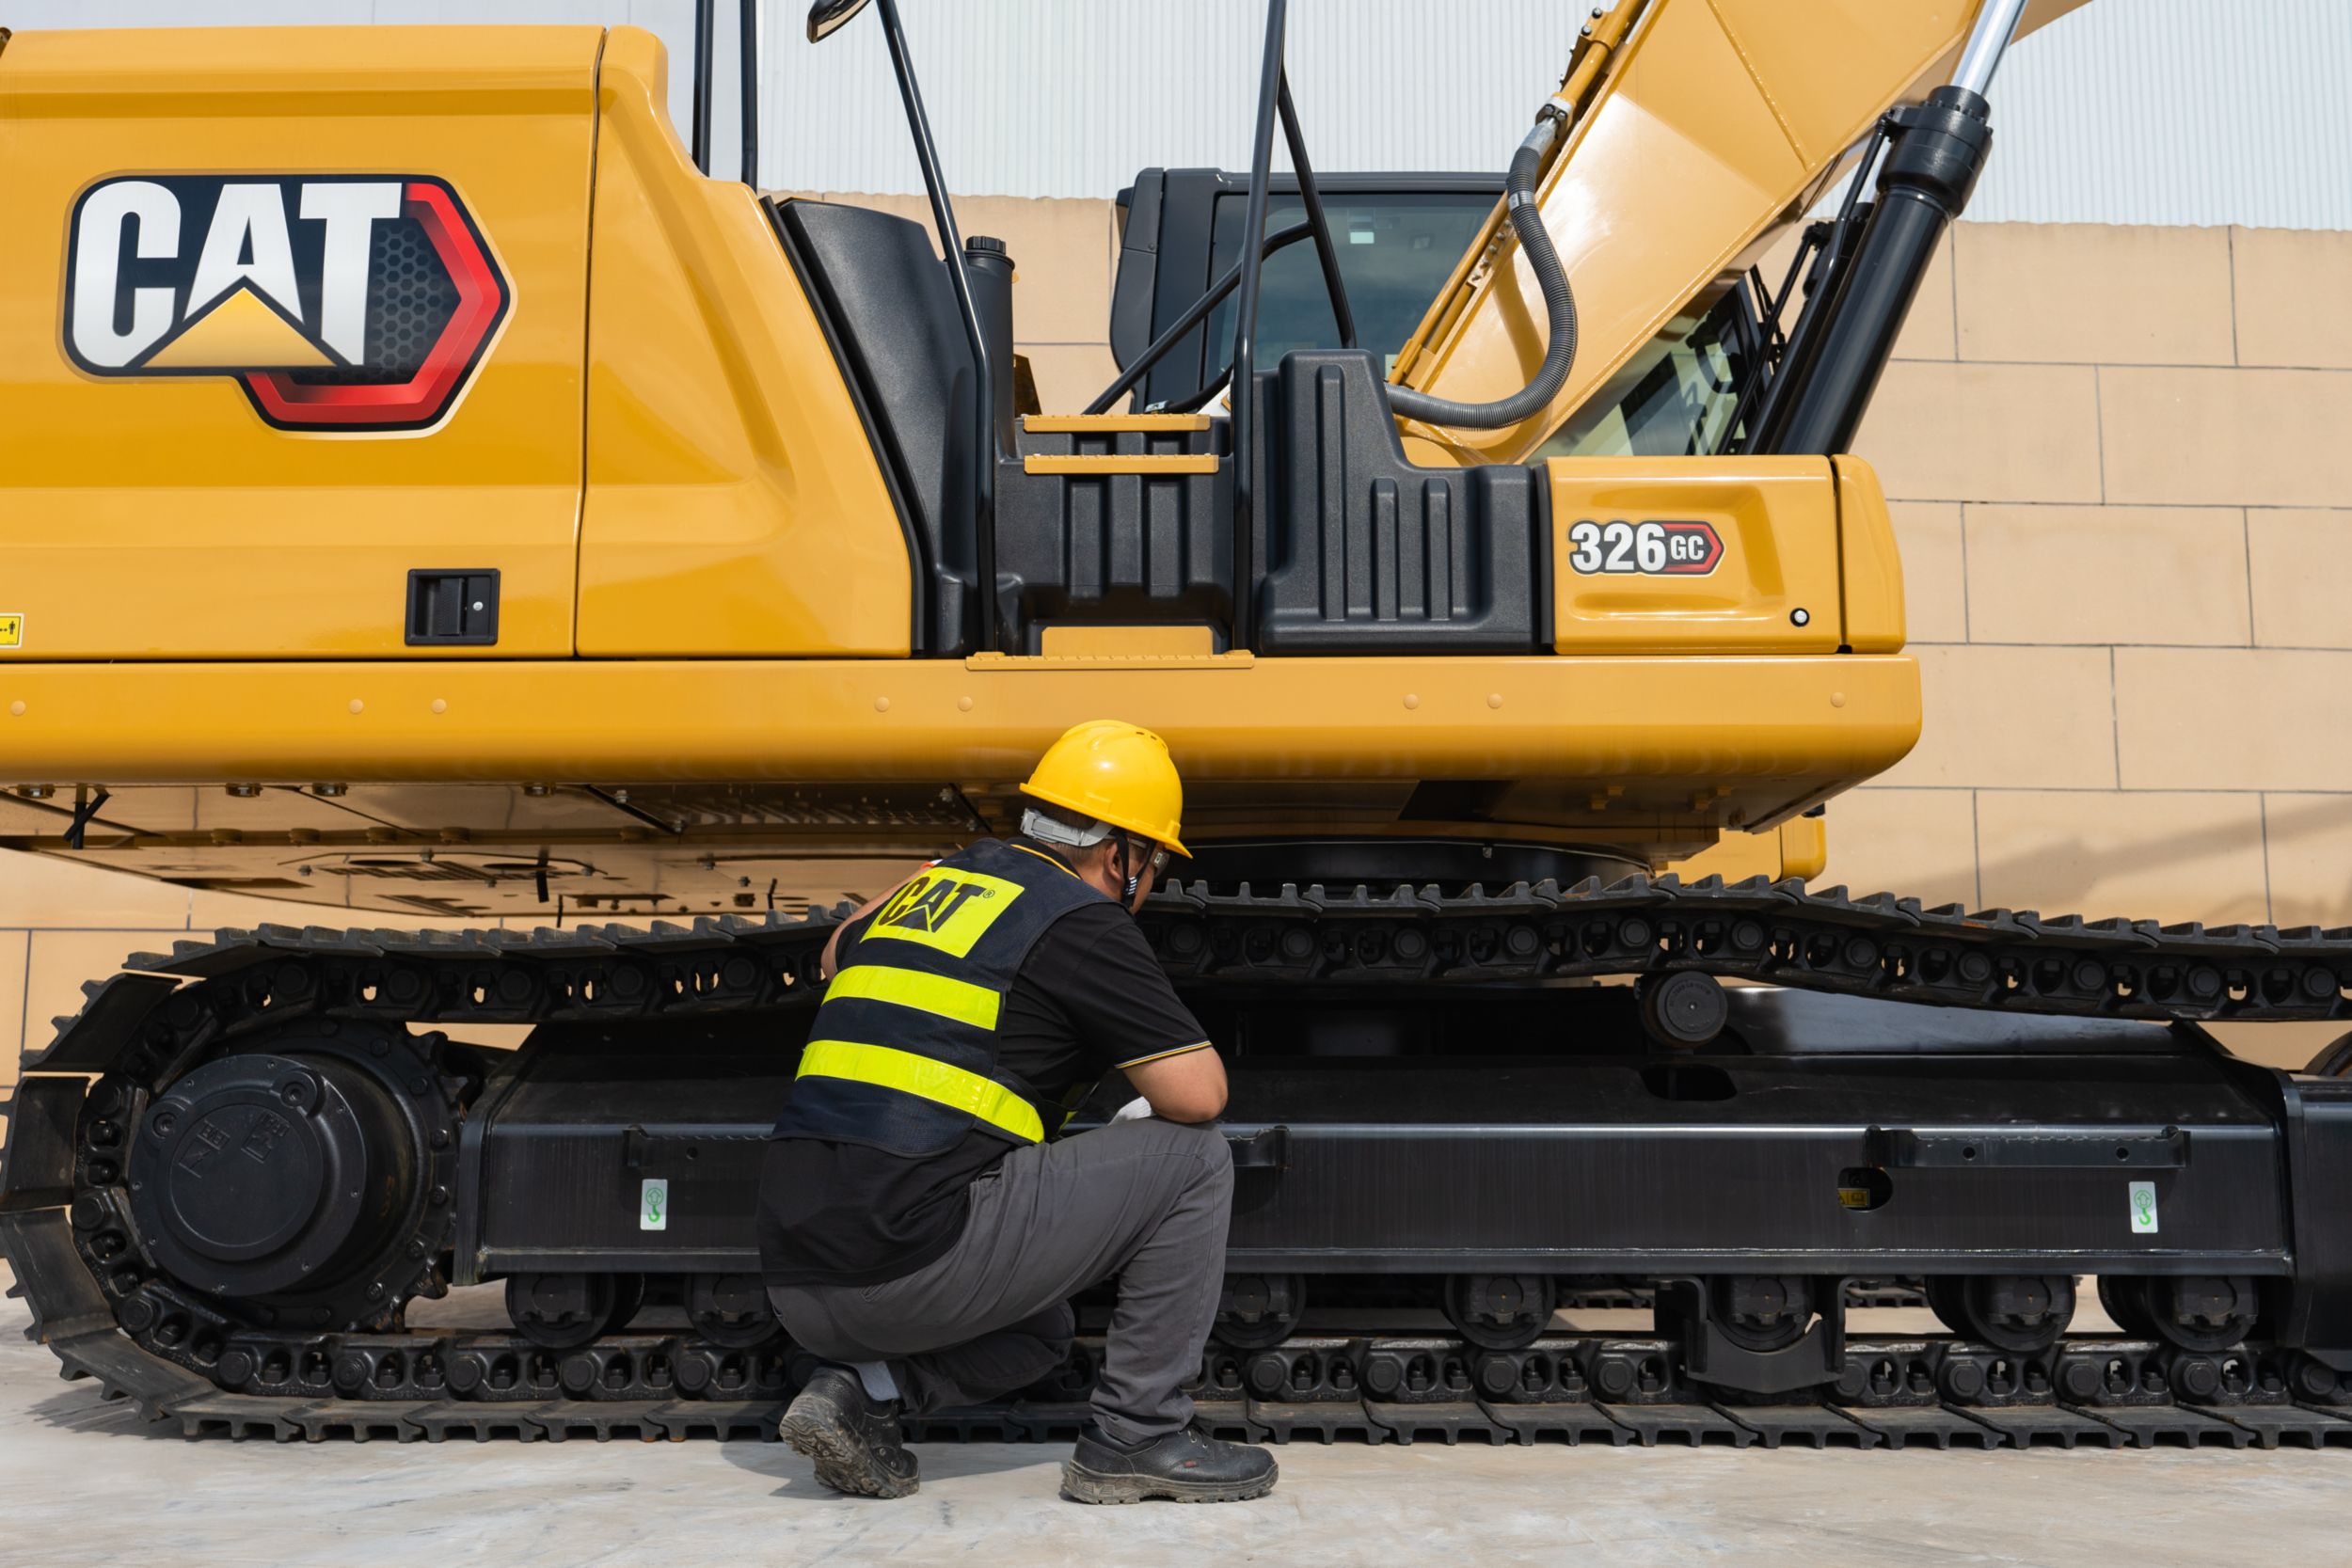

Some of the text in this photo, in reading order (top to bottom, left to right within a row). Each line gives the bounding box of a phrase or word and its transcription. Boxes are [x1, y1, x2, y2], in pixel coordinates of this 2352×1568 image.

[72, 181, 402, 368] CAT
[1571, 523, 1704, 571] 326 GC
